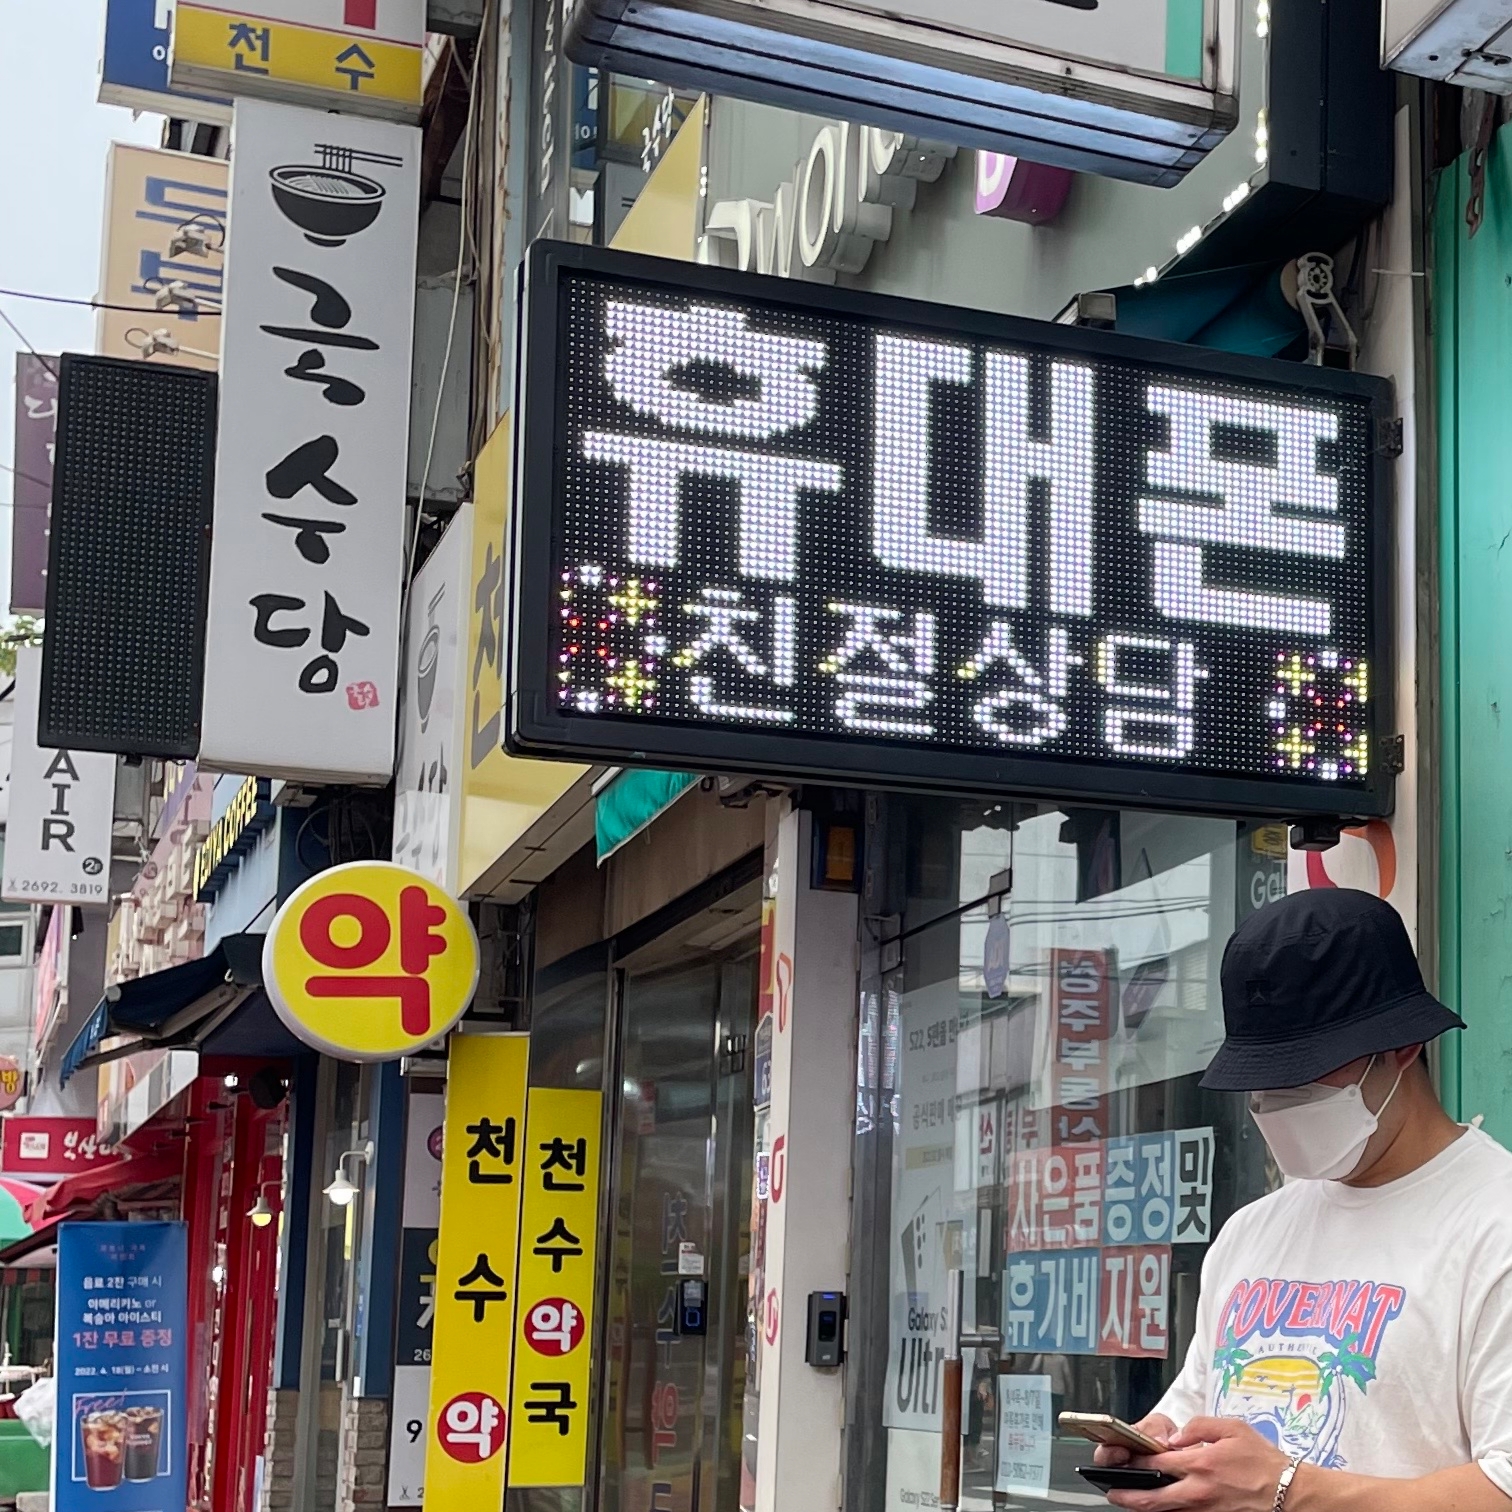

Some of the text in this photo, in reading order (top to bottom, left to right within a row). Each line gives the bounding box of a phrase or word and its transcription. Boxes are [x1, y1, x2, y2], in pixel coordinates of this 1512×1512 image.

[581, 300, 1346, 635] 휴대폰
[673, 588, 1207, 758] 친절상담
[301, 886, 447, 1035] 약
[1008, 1138, 1215, 1246] 사은품 증정 및
[73, 1328, 172, 1349] 1잔 무료 증정
[117, 1310, 162, 1325] 아이스티
[524, 1136, 588, 1437] 천수약국
[1008, 1247, 1169, 1354] 휴가비 지원
[899, 1336, 944, 1417] Ultr
